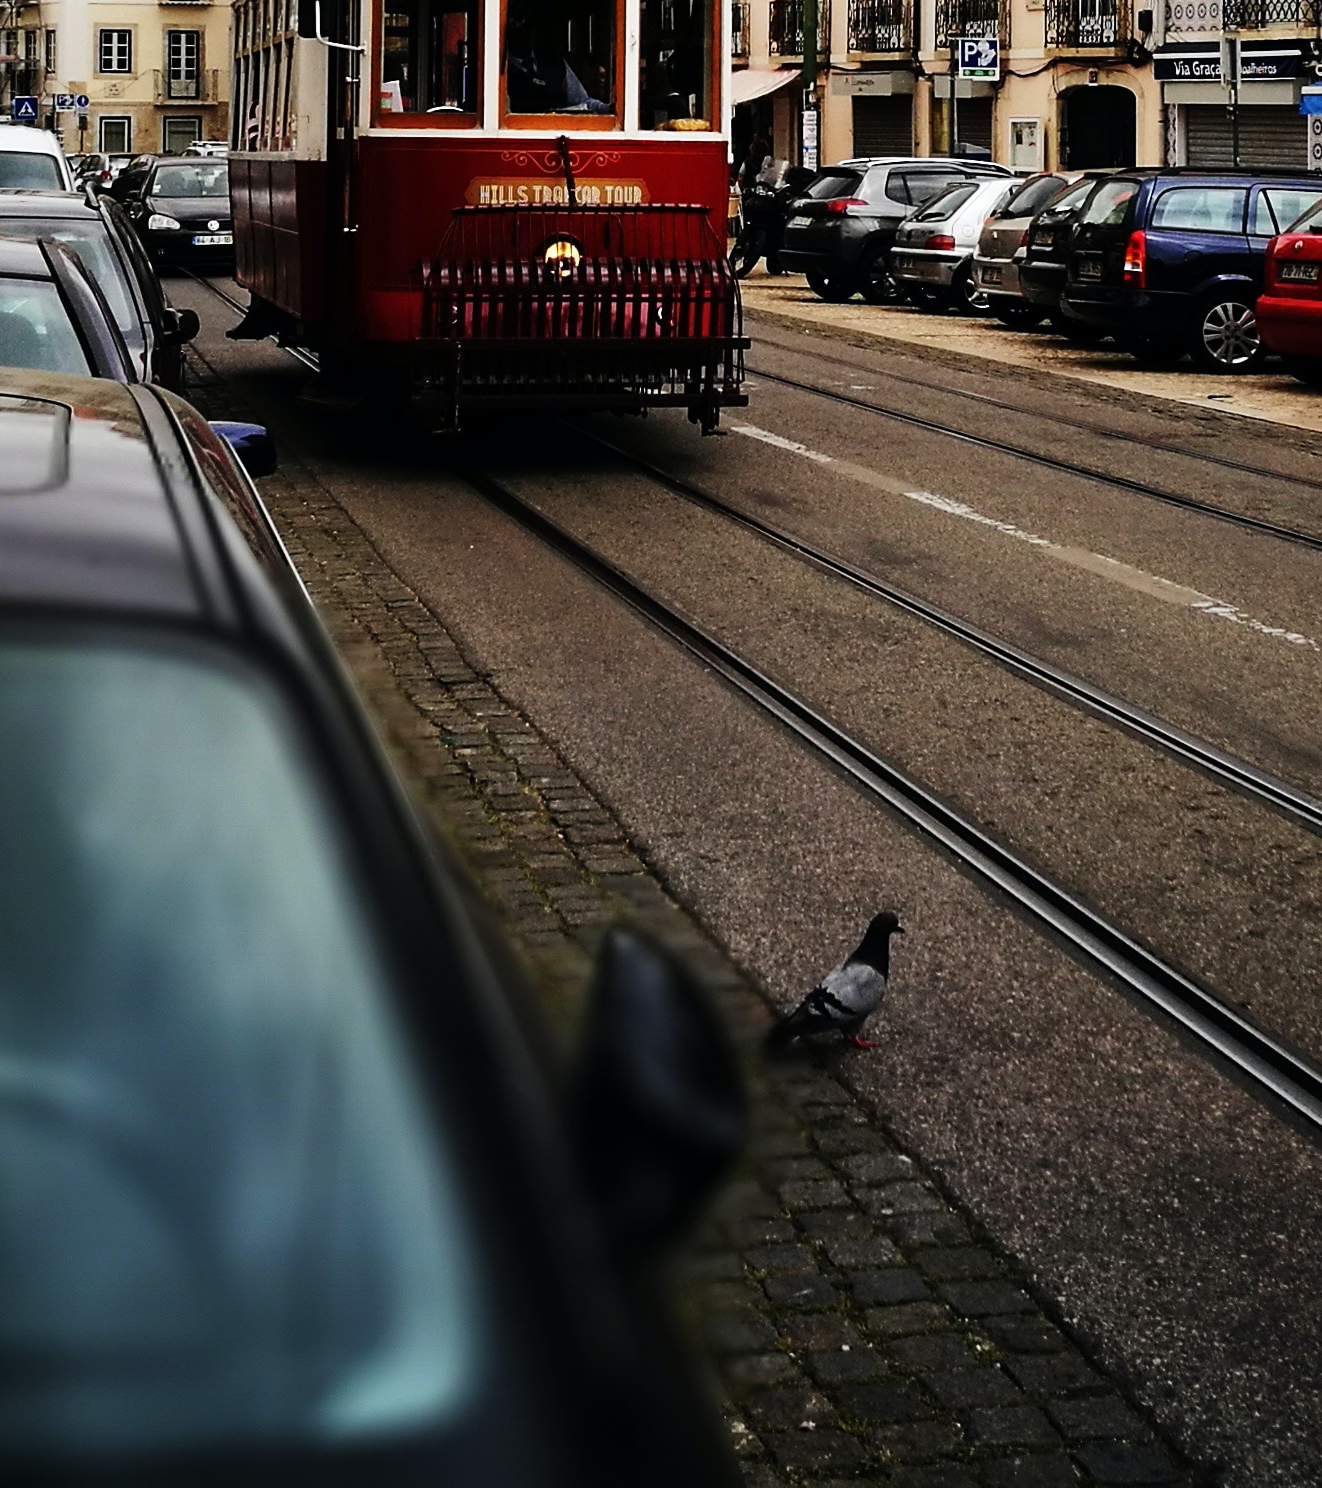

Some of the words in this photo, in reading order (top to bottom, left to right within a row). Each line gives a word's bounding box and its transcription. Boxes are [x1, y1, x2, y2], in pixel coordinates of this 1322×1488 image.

[964, 41, 977, 63] P
[1173, 61, 1189, 76] Via
[480, 185, 528, 205] HILLS
[604, 185, 643, 205] TOUR
